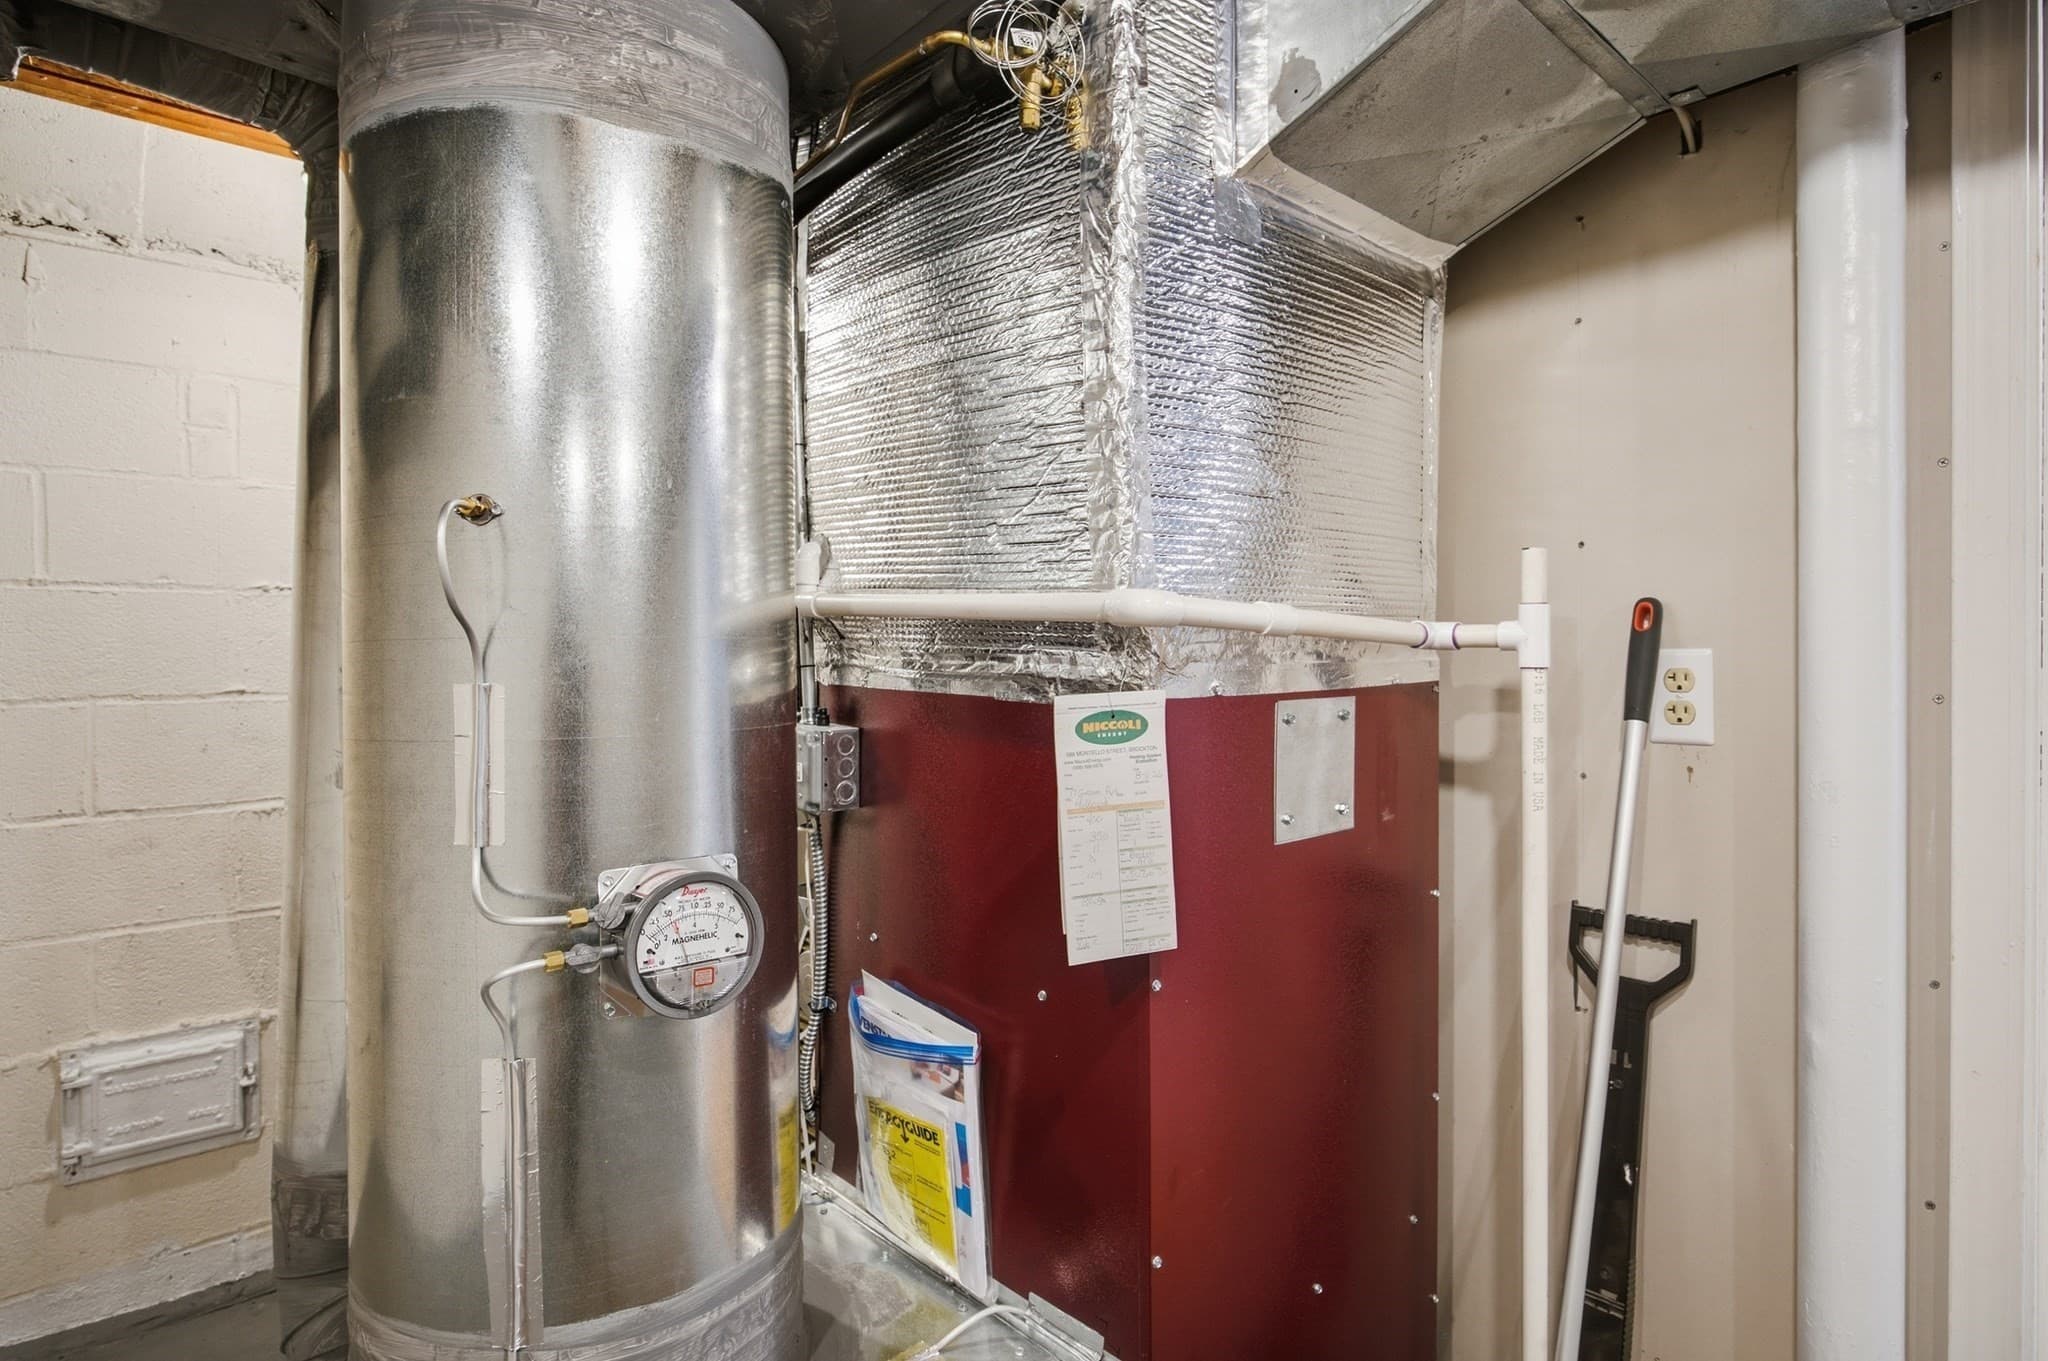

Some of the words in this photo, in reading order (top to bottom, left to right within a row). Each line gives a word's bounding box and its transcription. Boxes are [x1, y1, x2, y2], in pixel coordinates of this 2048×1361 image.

[1082, 719, 1142, 734] NICCOLI
[1533, 736, 1545, 765] MADE
[1533, 772, 1545, 785] IN
[1533, 791, 1545, 813] USA
[682, 886, 708, 898] Dwyer
[672, 931, 718, 945] MAGNEHELIC
